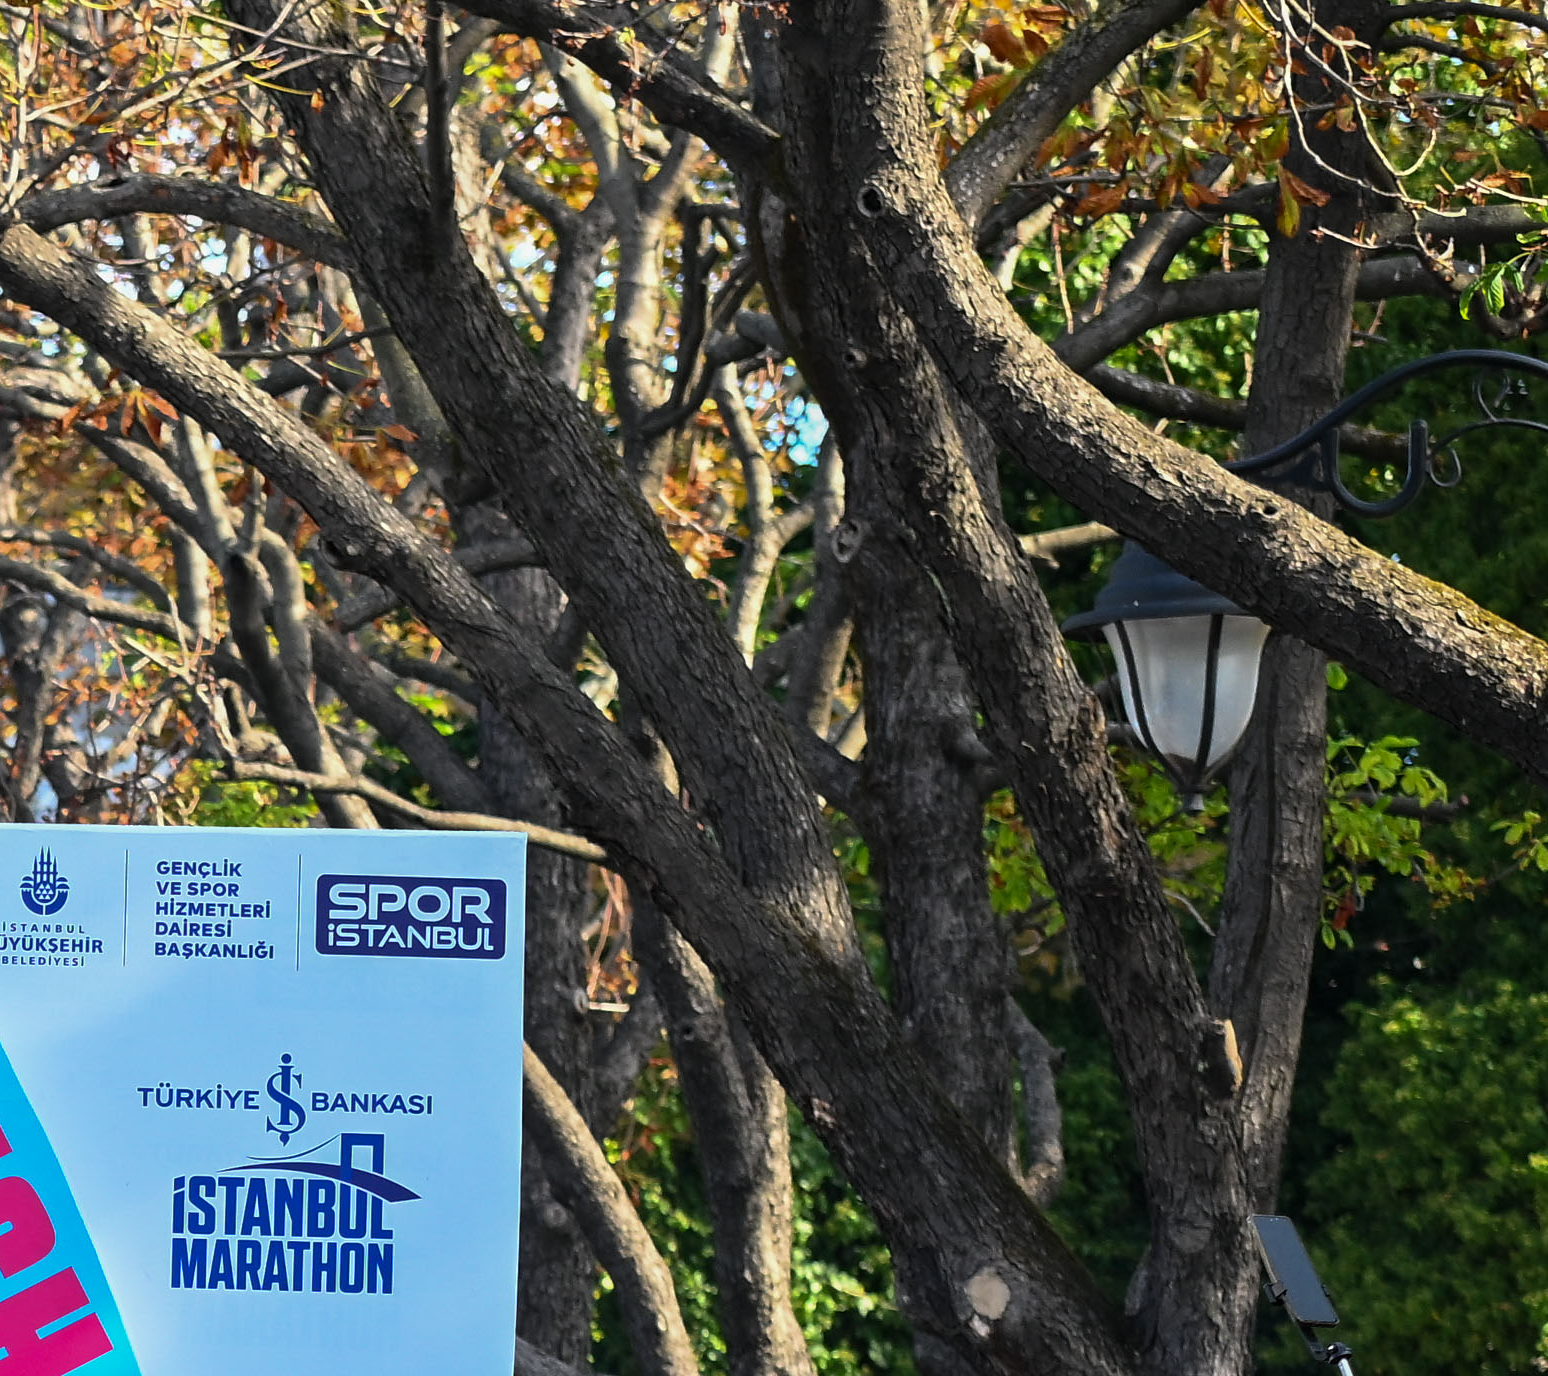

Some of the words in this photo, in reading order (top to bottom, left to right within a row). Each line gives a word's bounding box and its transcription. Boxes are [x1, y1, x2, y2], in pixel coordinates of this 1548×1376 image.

[157, 859, 242, 879] GENÇLİK
[157, 882, 181, 895] VE
[187, 882, 239, 897] SPOR
[156, 899, 271, 918] HİZMETLERİ
[329, 883, 493, 924] SPOR
[2, 922, 84, 934] İSTANBUL
[156, 920, 232, 937] DAİRESİ
[156, 940, 274, 960] BAŞKANLIĞI
[1, 955, 84, 967] BELEDİYESİ
[137, 1083, 260, 1110] TÜRKİYE
[311, 1092, 432, 1115] BANKASI
[173, 1175, 393, 1240] İSTANBUL
[171, 1238, 393, 1294] MARATHON
